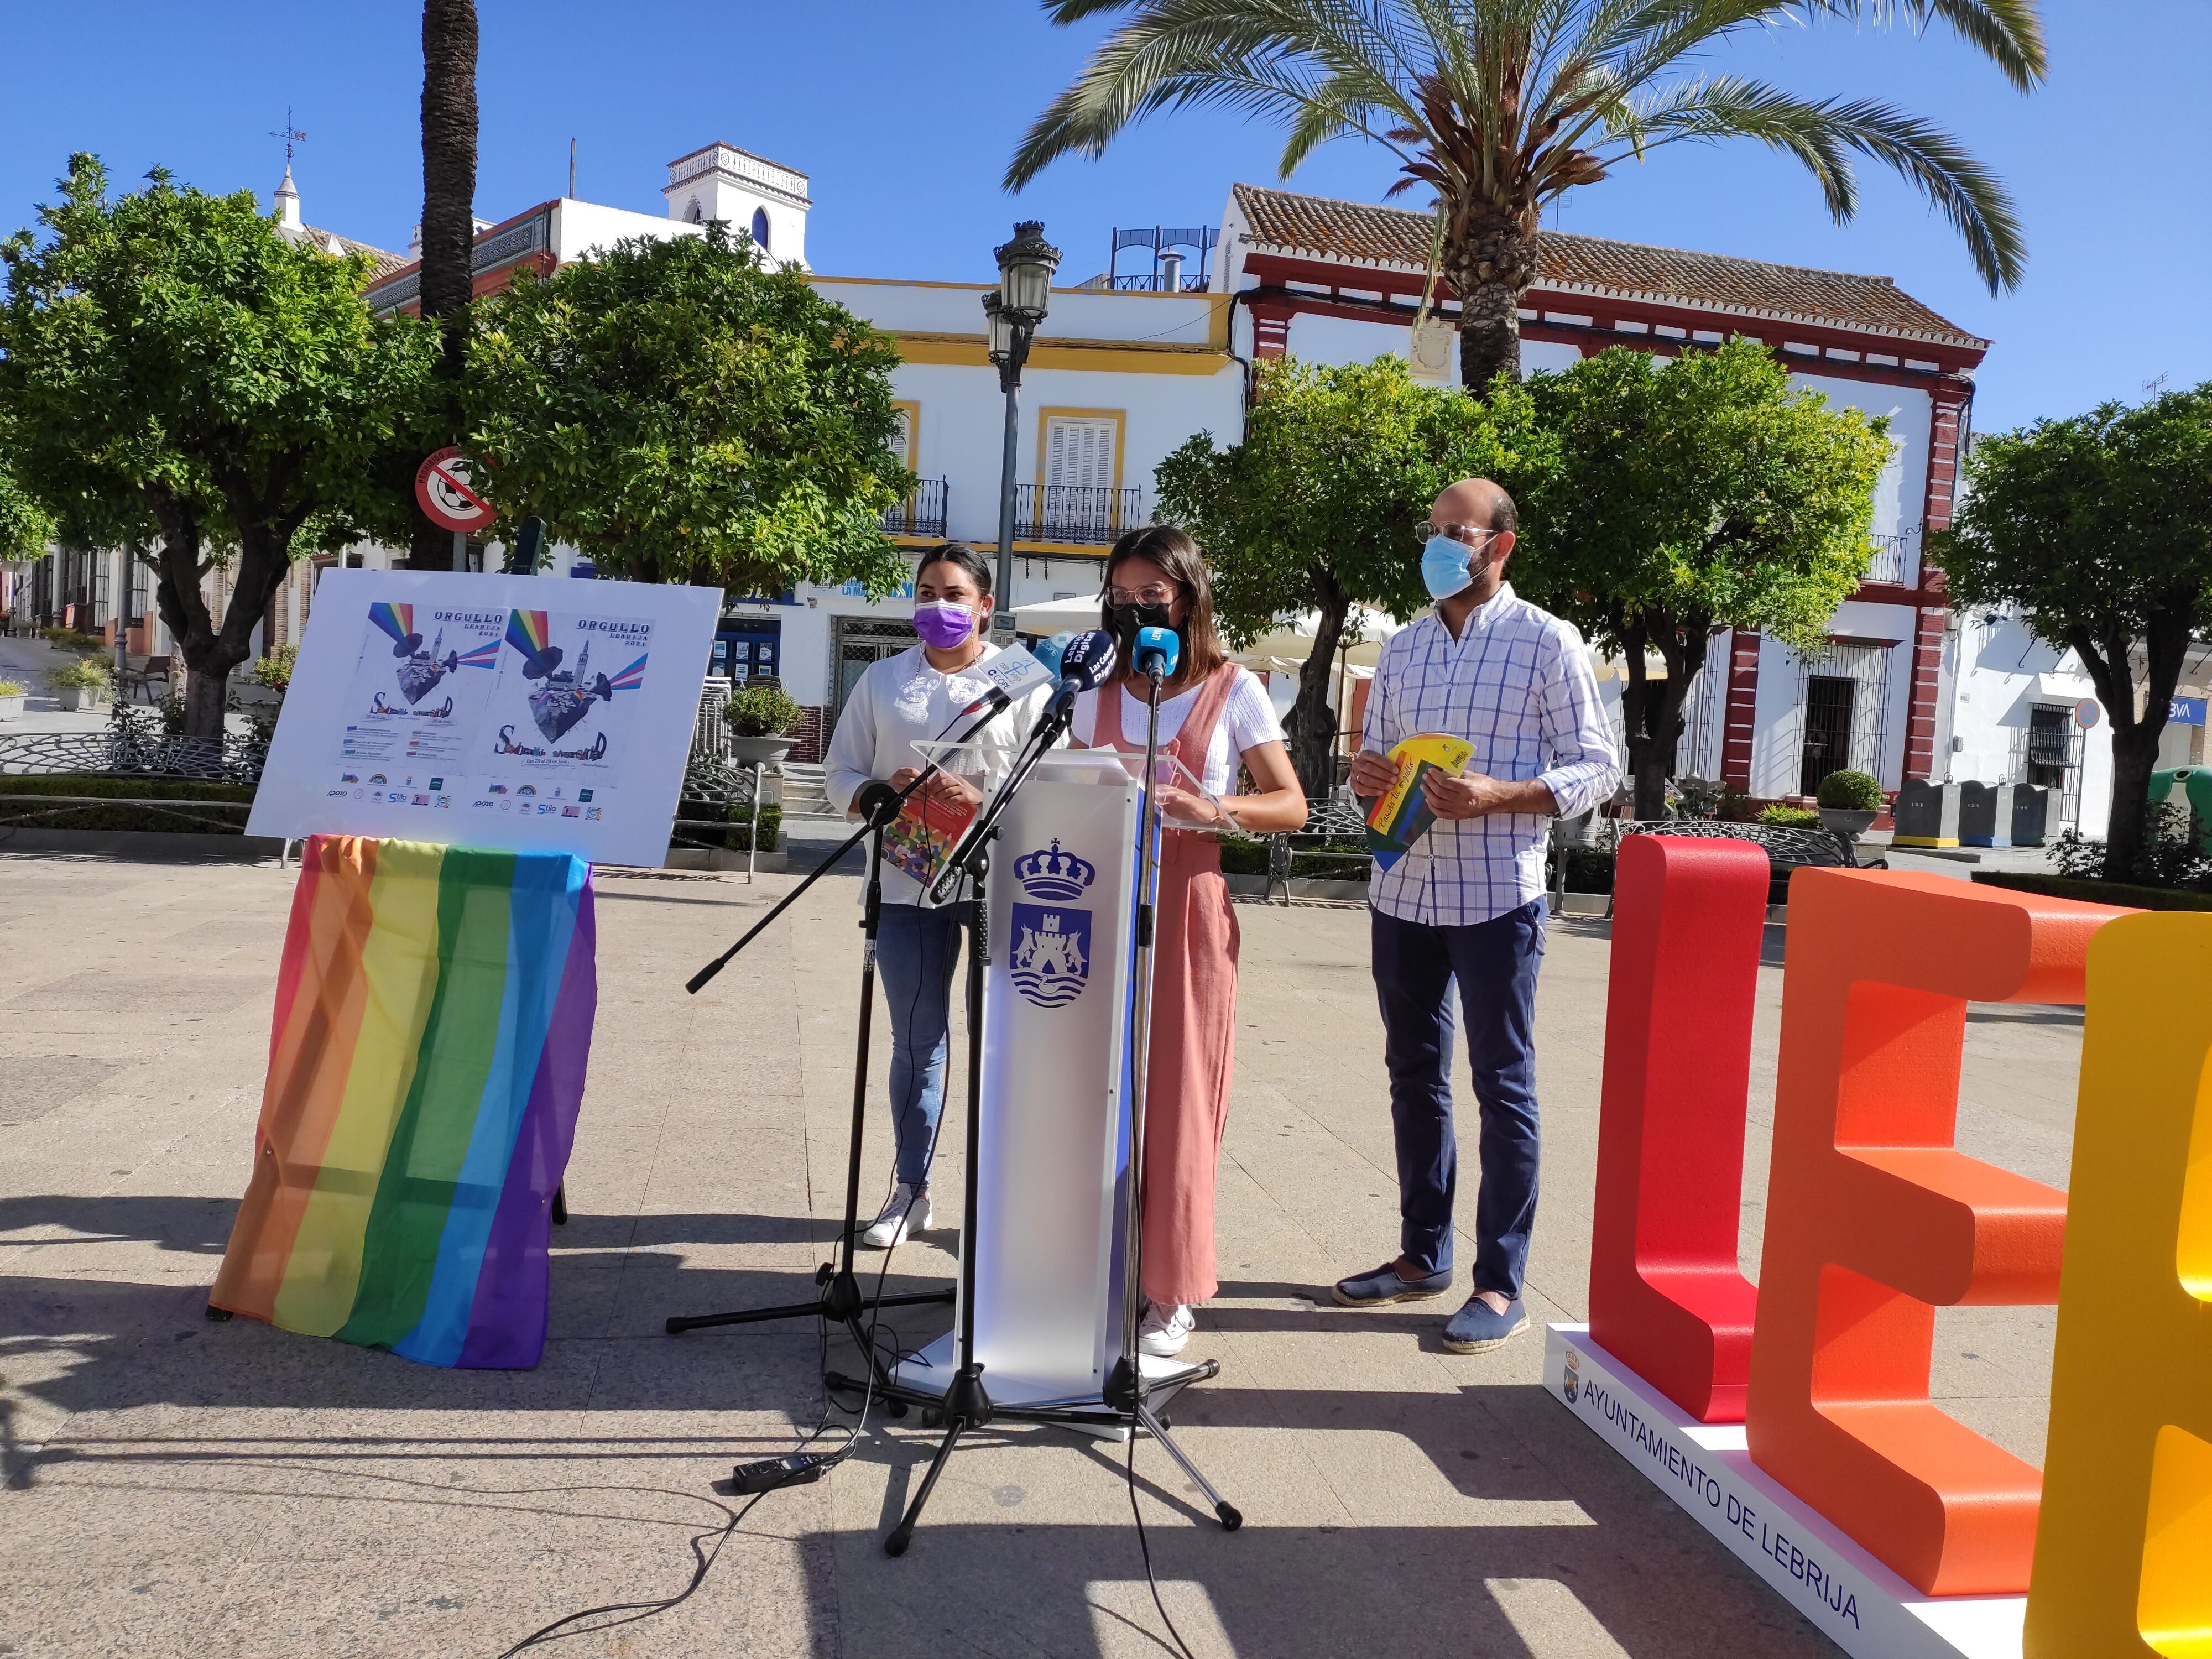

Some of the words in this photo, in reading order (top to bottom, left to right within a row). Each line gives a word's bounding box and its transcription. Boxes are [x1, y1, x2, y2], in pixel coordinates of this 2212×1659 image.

[418, 452, 444, 484] PROHIBIDO
[842, 586, 852, 596] LA
[853, 586, 867, 597] MA
[435, 611, 503, 623] ORGULLO
[578, 619, 649, 633] ORGULLO
[1065, 632, 1086, 664] Lebrija
[1074, 632, 1097, 663] Digital
[1089, 662, 1101, 674] Las
[1094, 651, 1117, 684] Digital
[994, 675, 1011, 691] COPE
[2169, 702, 2190, 718] BVA
[1391, 790, 1400, 799] tu
[1584, 1379, 1721, 1508] AYUNTAMIENTO
[1726, 1493, 1756, 1541] DE
[1761, 1522, 1860, 1631] LEBRIJA
